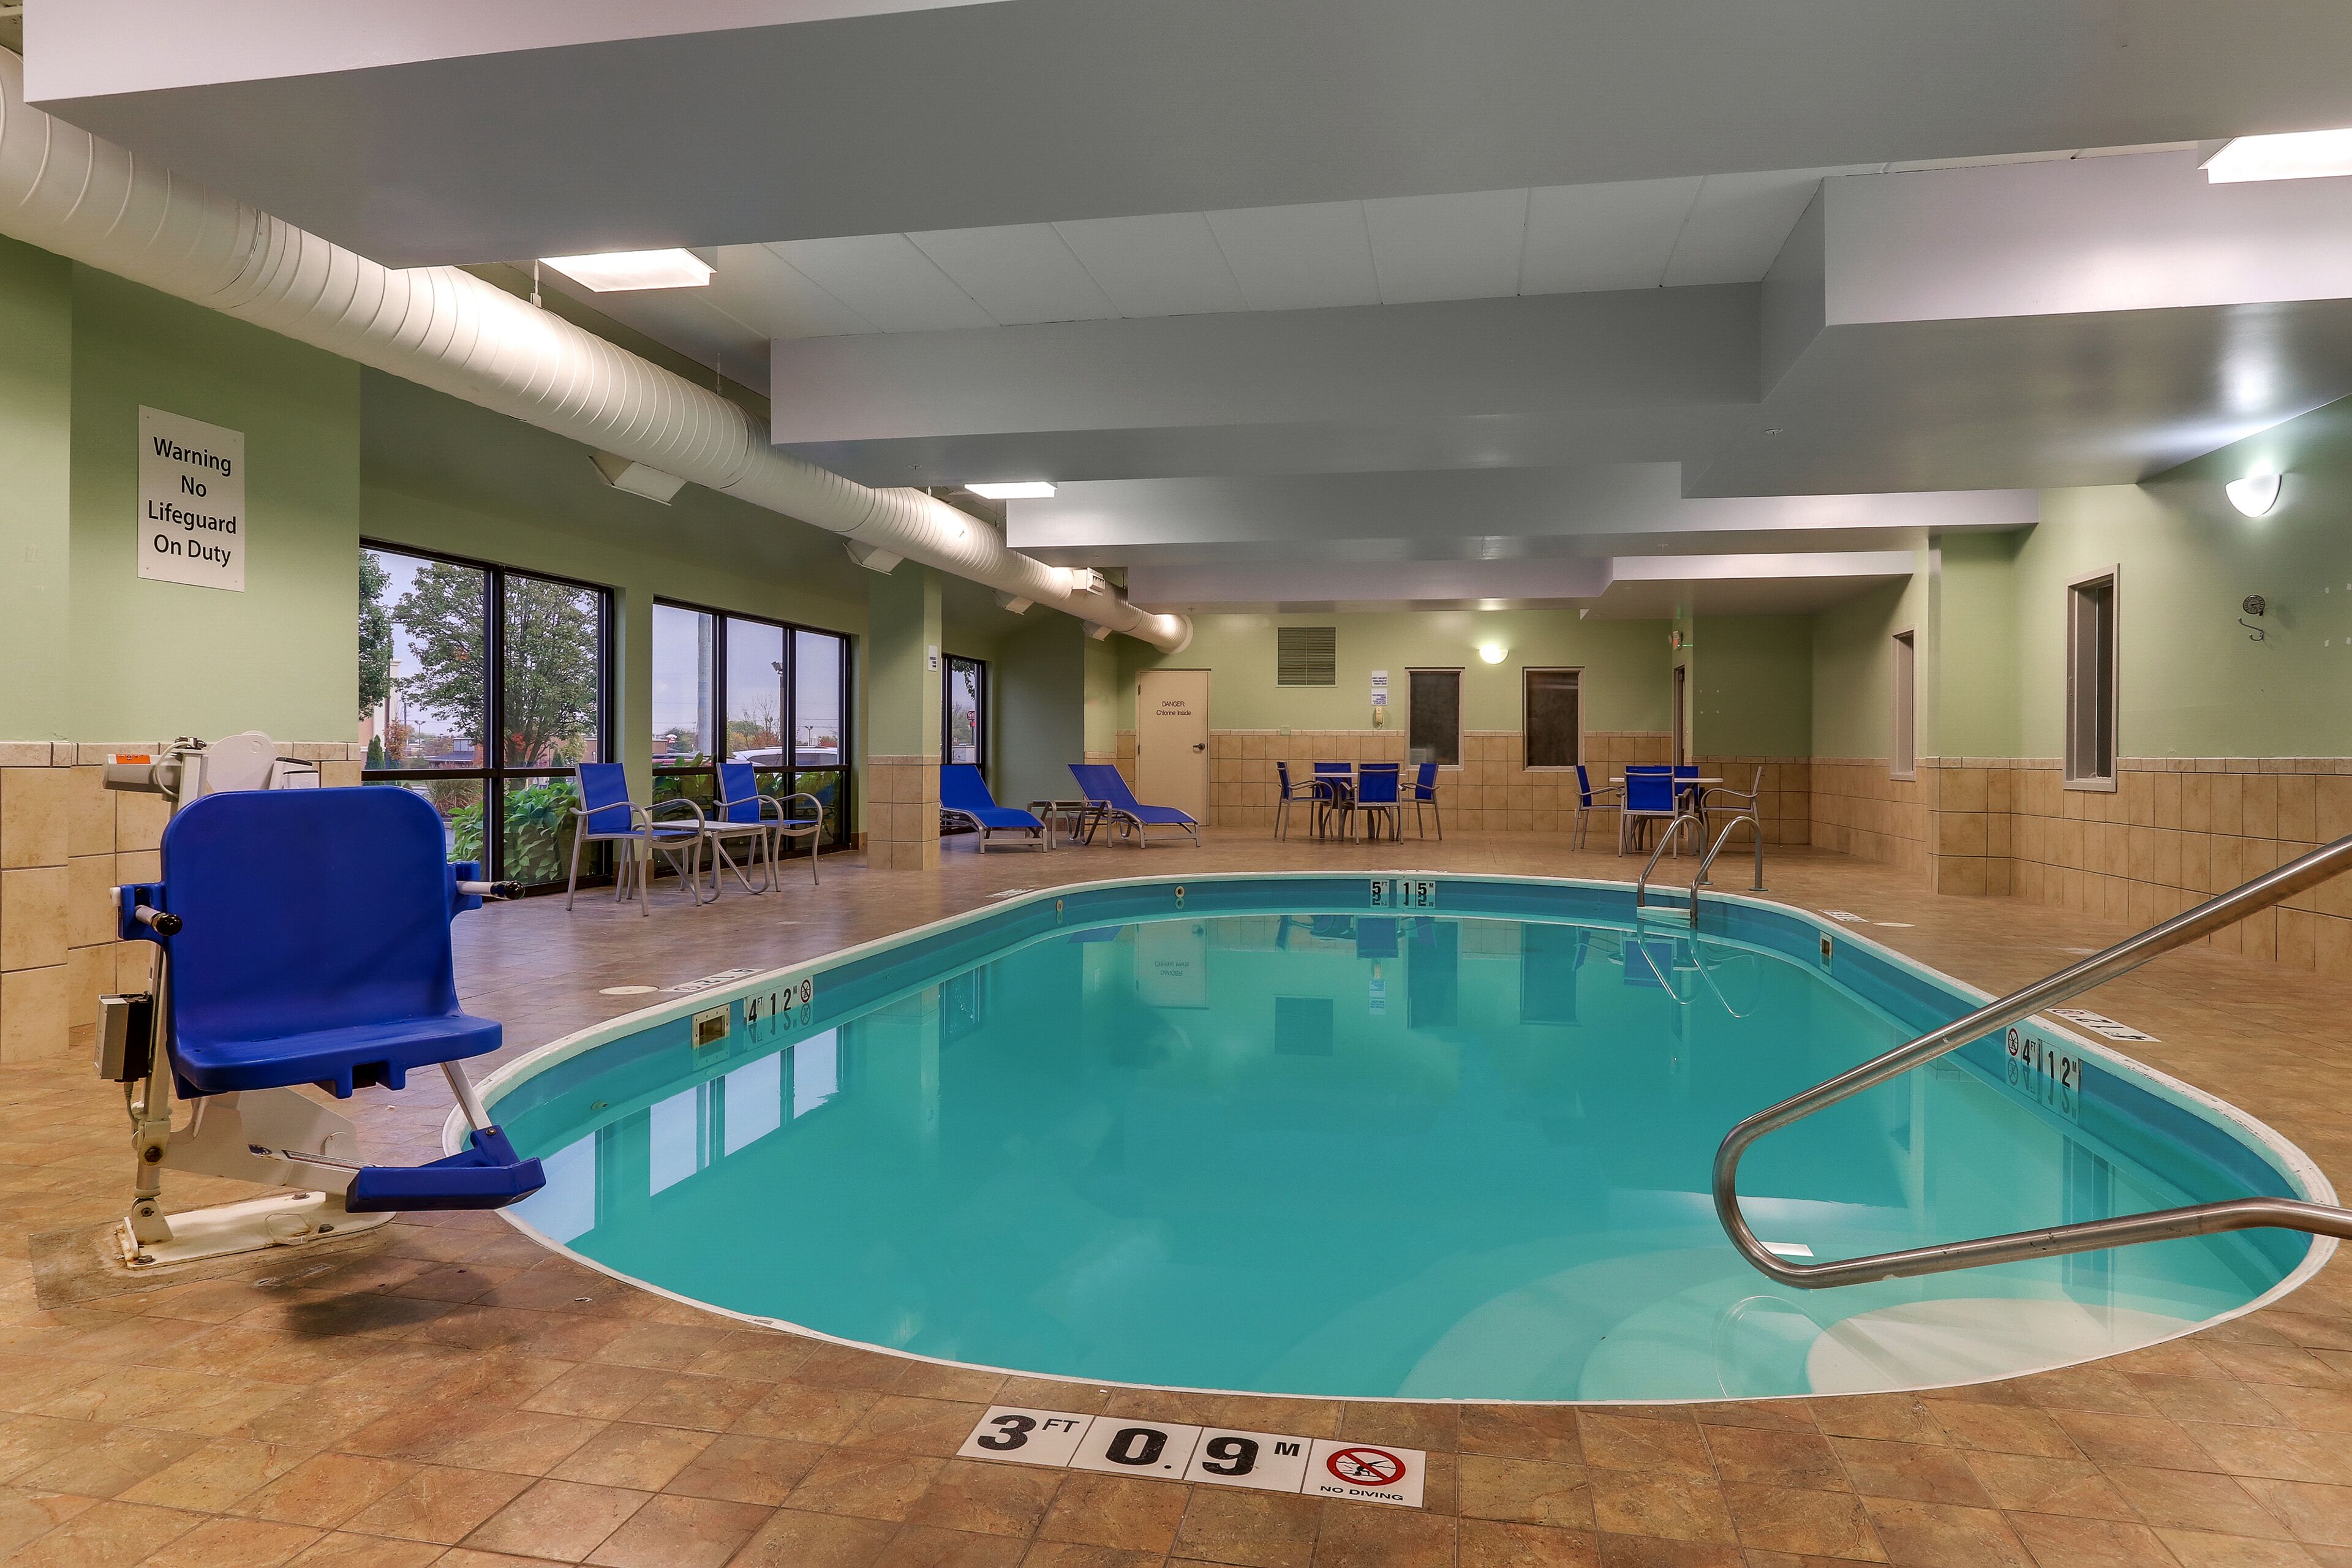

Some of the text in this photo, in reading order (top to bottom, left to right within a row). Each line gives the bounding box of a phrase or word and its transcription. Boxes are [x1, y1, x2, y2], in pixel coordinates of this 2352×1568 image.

[153, 436, 231, 477] Warning
[181, 475, 207, 497] No
[148, 500, 236, 534] Lifeguard
[154, 534, 231, 568] On Duty
[1372, 881, 1381, 894] 5
[748, 998, 757, 1022] 4
[757, 997, 763, 1006] FT
[770, 993, 776, 1016] 1
[783, 988, 791, 1012] 2
[2022, 1038, 2030, 1066] 4
[2030, 1041, 2036, 1052] FT
[2048, 1050, 2054, 1079] 1
[2062, 1057, 2070, 1088] 2
[978, 1415, 1037, 1450] 3
[1042, 1418, 1080, 1433] FT
[1274, 1442, 1300, 1457] M
[1349, 1489, 1403, 1501] DIVING
